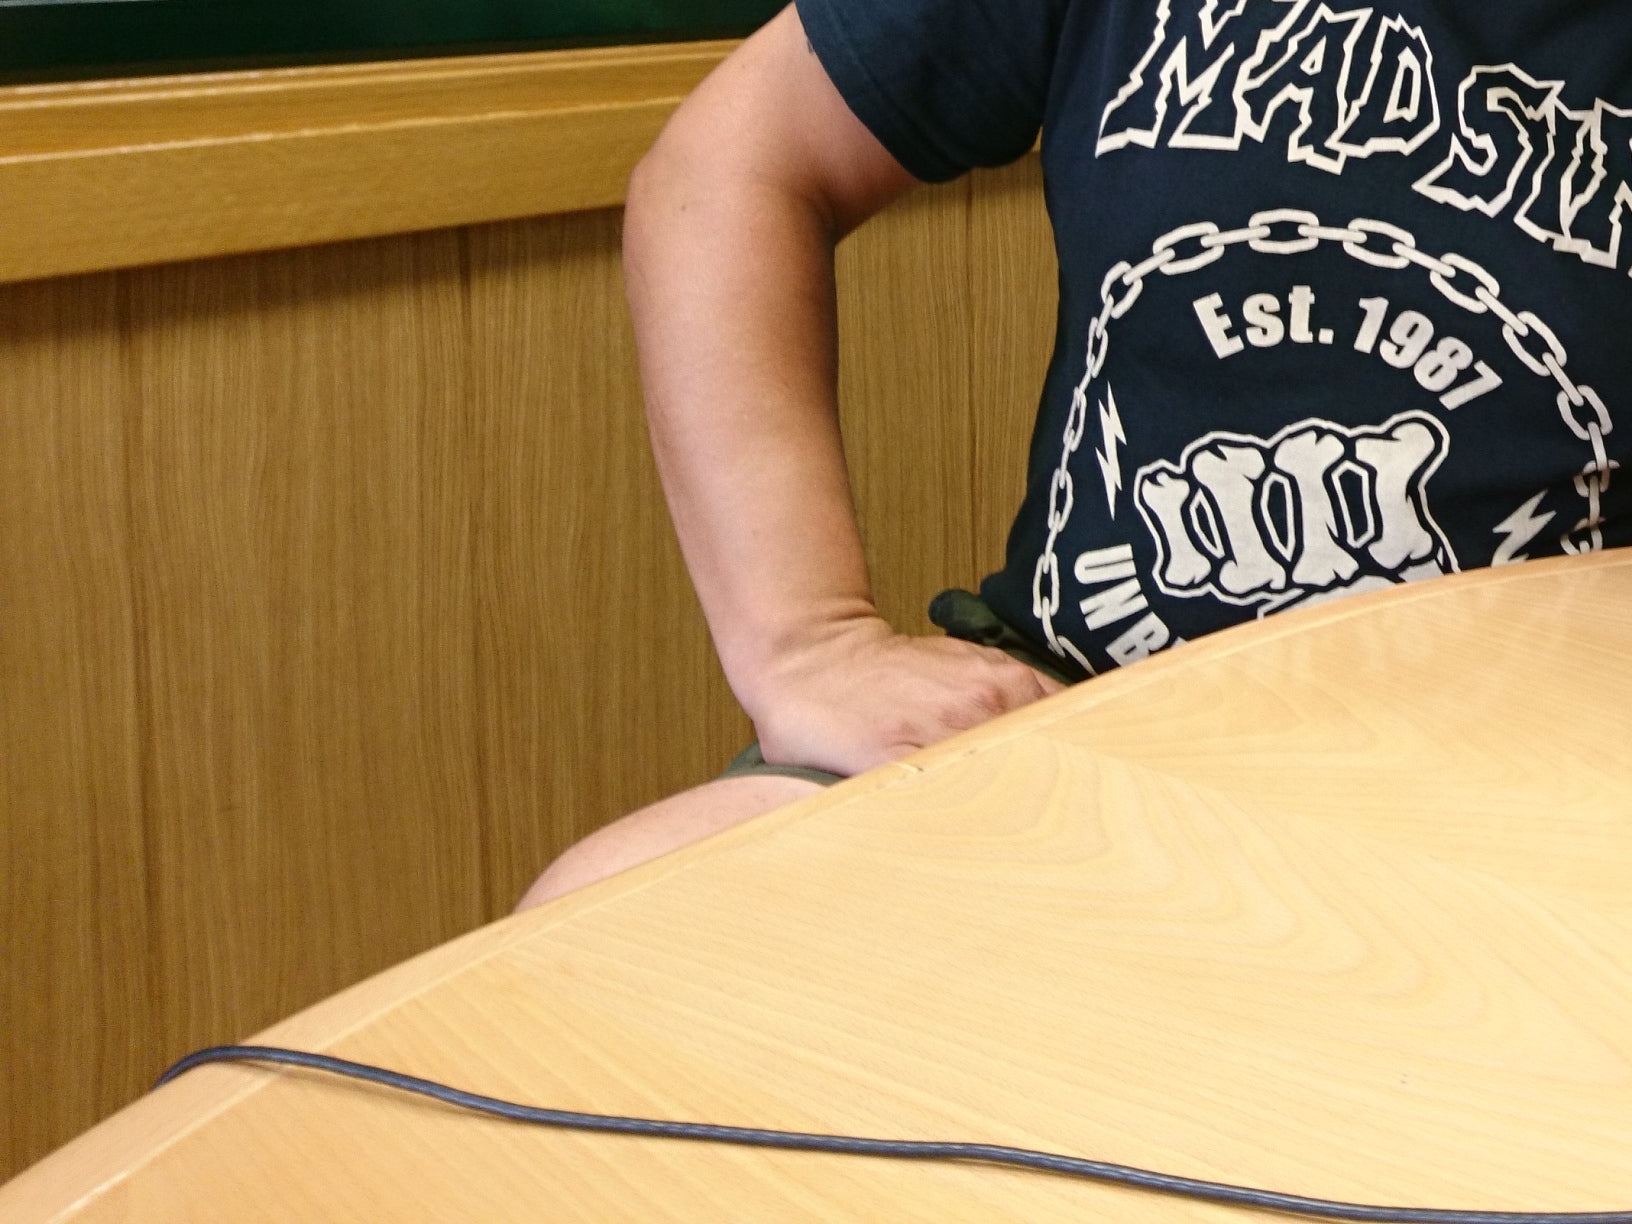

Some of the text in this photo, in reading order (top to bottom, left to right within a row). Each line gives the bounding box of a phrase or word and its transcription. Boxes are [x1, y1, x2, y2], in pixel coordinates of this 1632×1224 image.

[1193, 284, 1503, 410] Est. 1987
[1074, 543, 1189, 668] UNB
